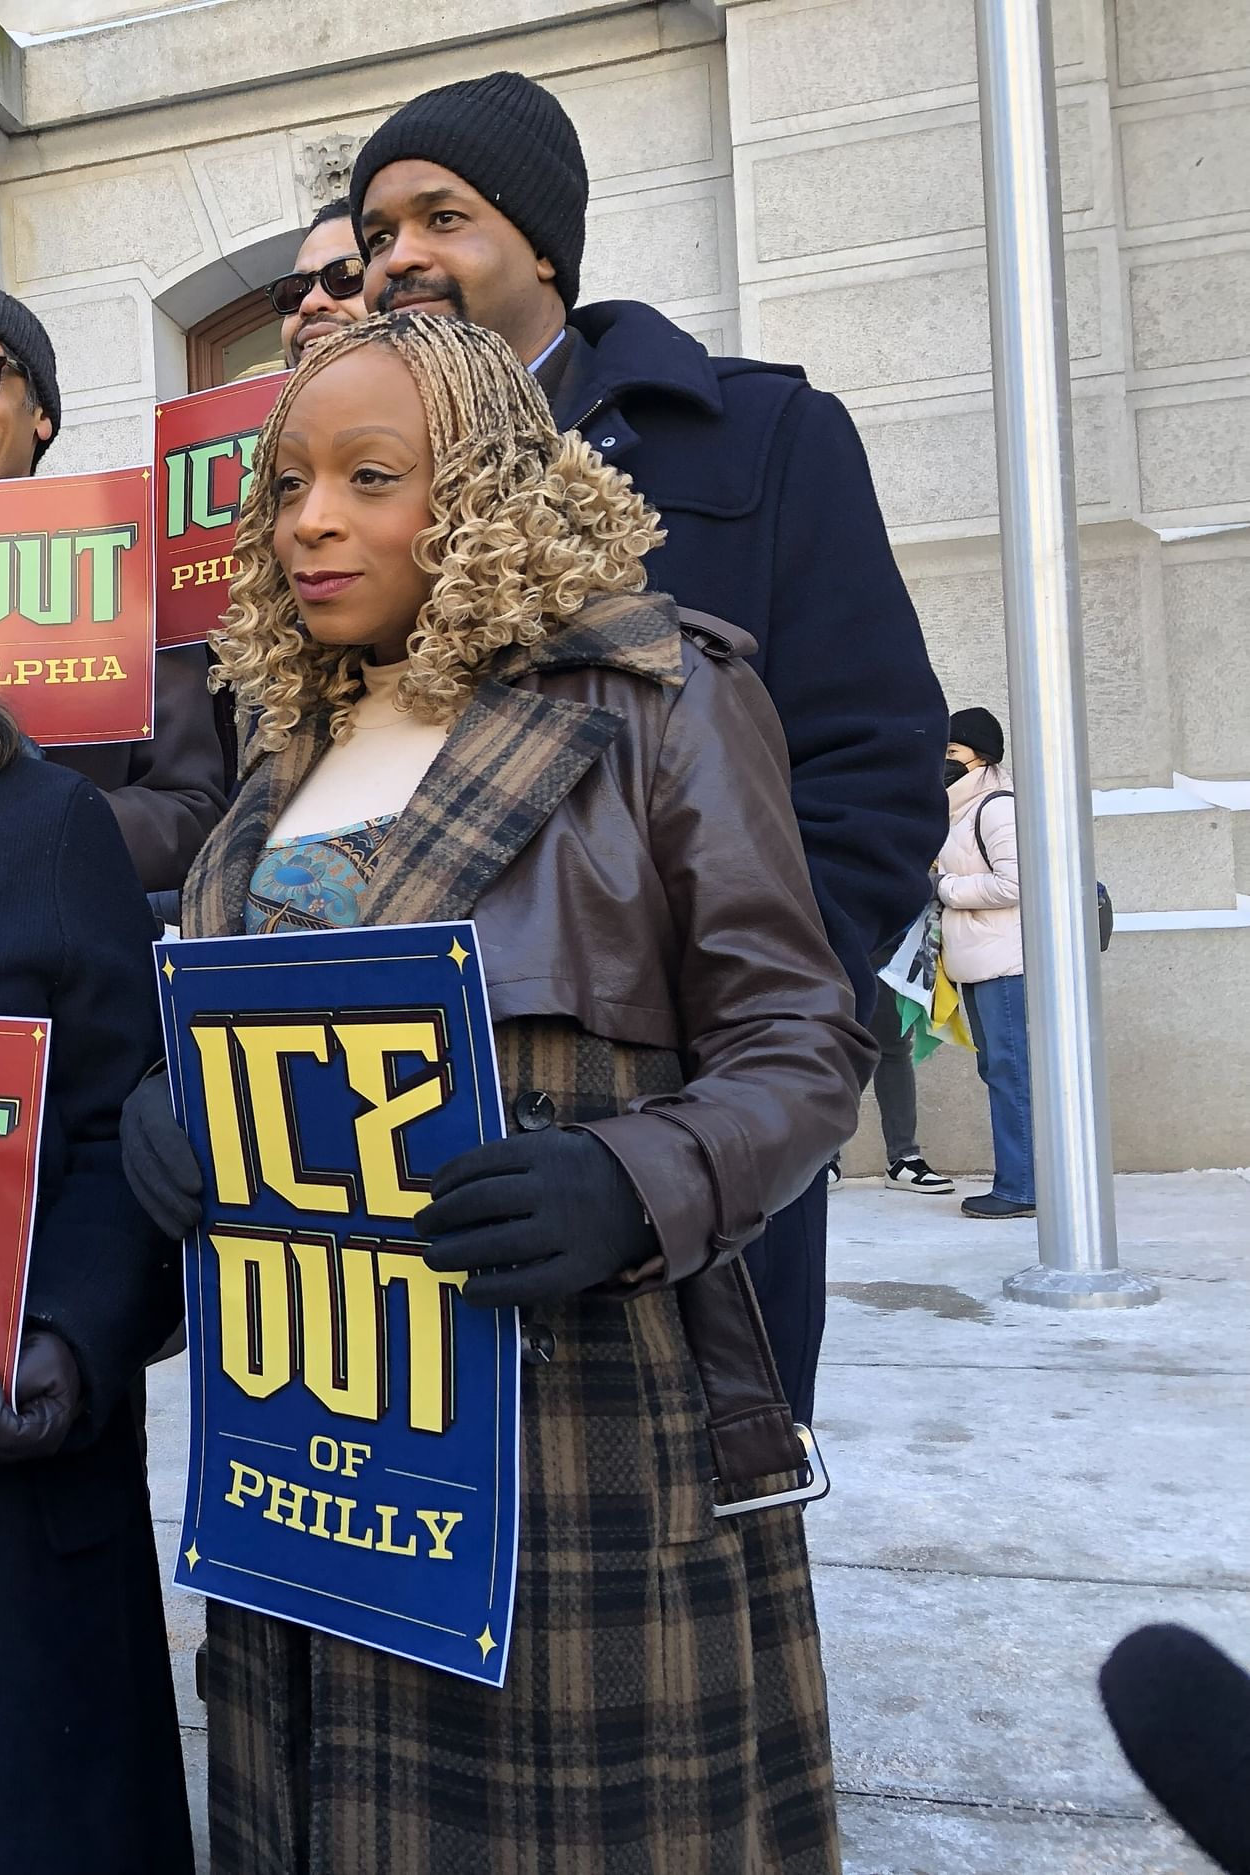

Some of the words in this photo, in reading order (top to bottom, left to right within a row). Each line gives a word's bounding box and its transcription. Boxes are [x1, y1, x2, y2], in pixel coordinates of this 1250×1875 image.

[171, 555, 245, 590] PHI
[190, 1009, 452, 1219] ICE
[209, 1223, 468, 1434] OUT
[309, 1435, 371, 1478] OF
[225, 1459, 463, 1560] PHILLY
